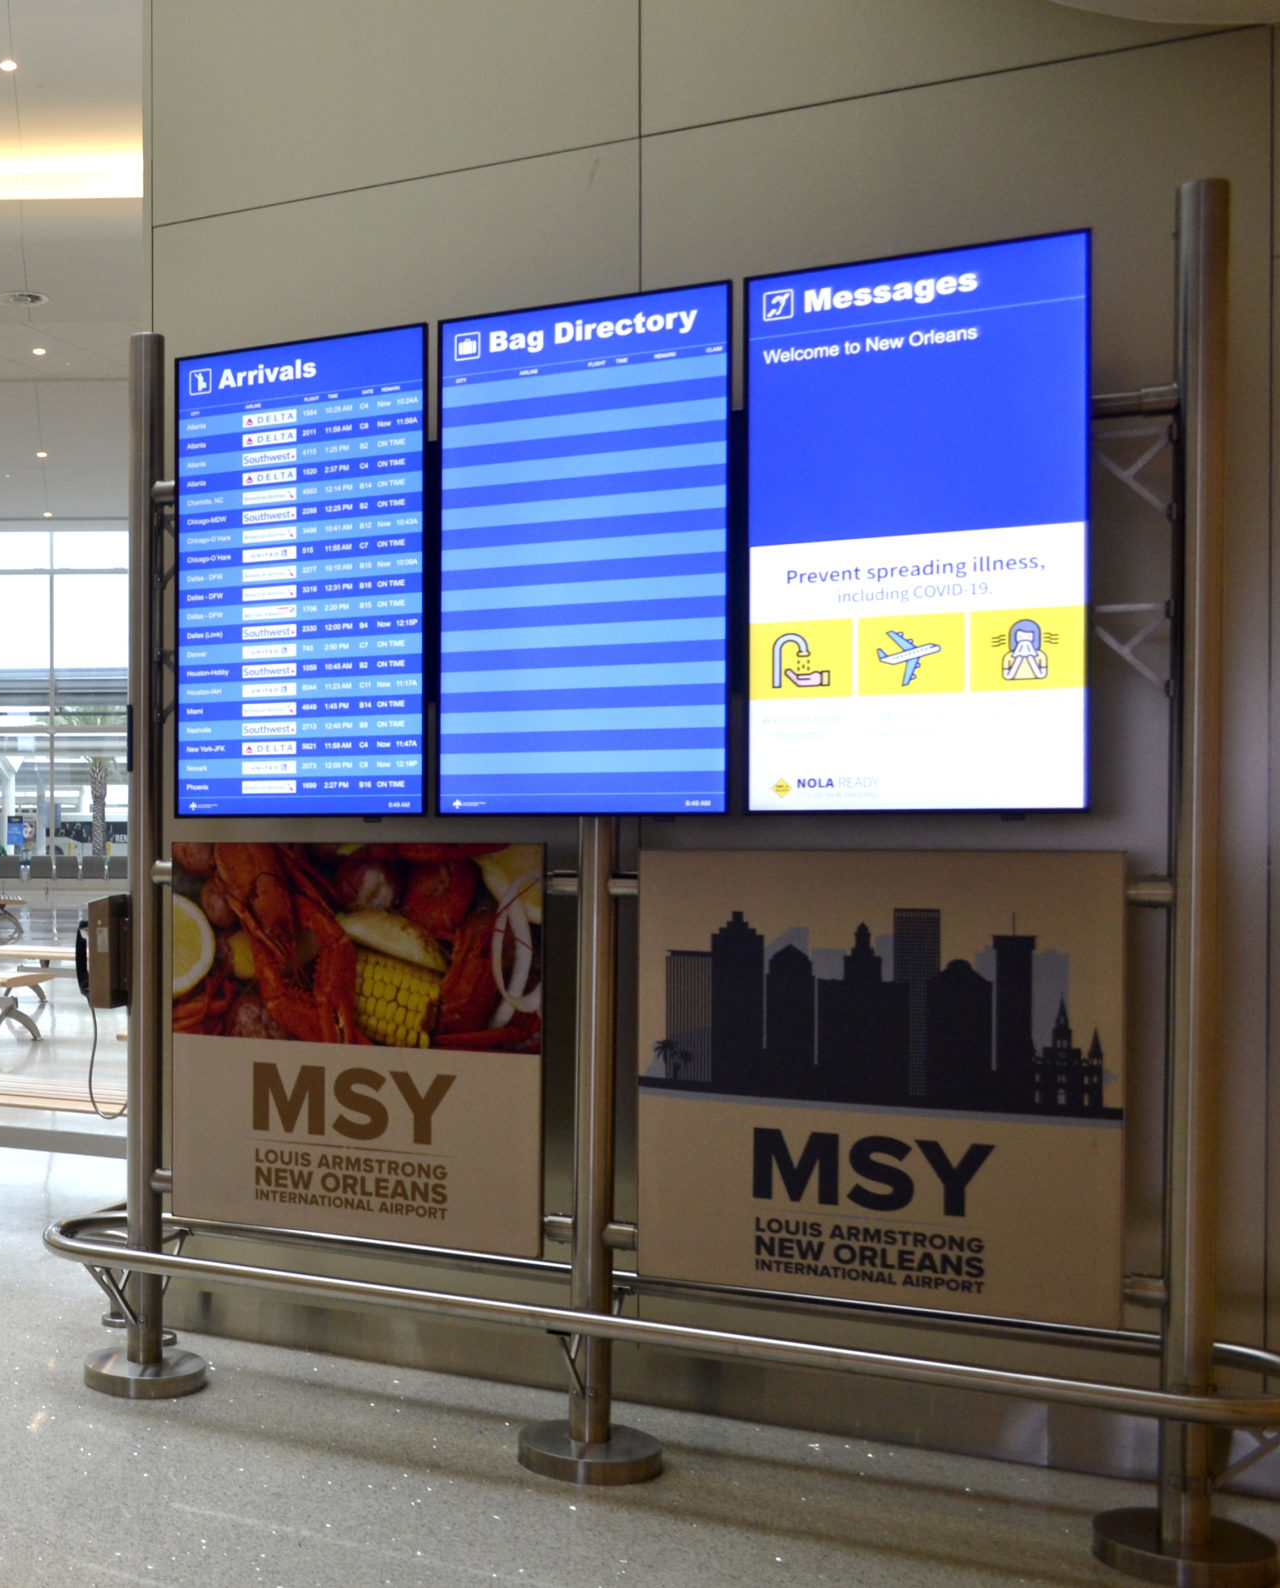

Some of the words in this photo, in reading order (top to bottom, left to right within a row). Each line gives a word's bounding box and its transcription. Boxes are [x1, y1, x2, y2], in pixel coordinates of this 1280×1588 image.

[804, 272, 978, 313] Messages
[489, 330, 544, 353] Bag
[554, 309, 697, 344] Directory
[764, 344, 839, 364] Welcome
[845, 340, 860, 354] to
[866, 334, 904, 352] New
[909, 326, 978, 346] Orleans
[219, 359, 317, 389] Arrivals
[187, 422, 206, 431] Atlanta
[258, 412, 294, 424] DELTA
[377, 400, 391, 408] Now
[187, 441, 206, 450] Atlanta
[258, 432, 294, 443] DELTA
[377, 420, 391, 428] Now
[244, 452, 290, 464] Southwest
[390, 438, 406, 446] TIME
[187, 479, 206, 488] Atlanta
[258, 471, 294, 482] DELTA
[390, 458, 406, 466] TIME
[390, 478, 406, 487] TIME
[244, 511, 290, 522] Southwest
[390, 498, 406, 507] TIME
[787, 566, 860, 584] Prevent
[867, 560, 966, 582] spreading
[973, 555, 1045, 572] illness,
[838, 588, 909, 603] including
[913, 582, 992, 599] COVID-19.
[244, 628, 290, 637] Southwest
[187, 669, 229, 678] Houston-Hobby
[244, 667, 290, 676] Southwest
[244, 725, 290, 734] Southwest
[797, 778, 834, 788] NOLA
[839, 777, 879, 788] READY
[253, 1062, 457, 1145] MSY
[256, 1148, 311, 1167] LOUIS
[318, 1154, 448, 1180] ARMSTRONG
[753, 1127, 996, 1217] MSY
[256, 1166, 313, 1190] NEW
[321, 1172, 448, 1205] ORLEANS
[256, 1188, 373, 1212] INTERNATIONAL
[378, 1202, 448, 1220] AIRPORT
[756, 1217, 822, 1237] LOUIS
[829, 1224, 984, 1253] ARMSTRONG
[755, 1236, 824, 1260] NEW
[833, 1243, 985, 1278] ORLEANS
[755, 1259, 896, 1285] INTERNATIONAL
[902, 1274, 984, 1294] AIRPORT
